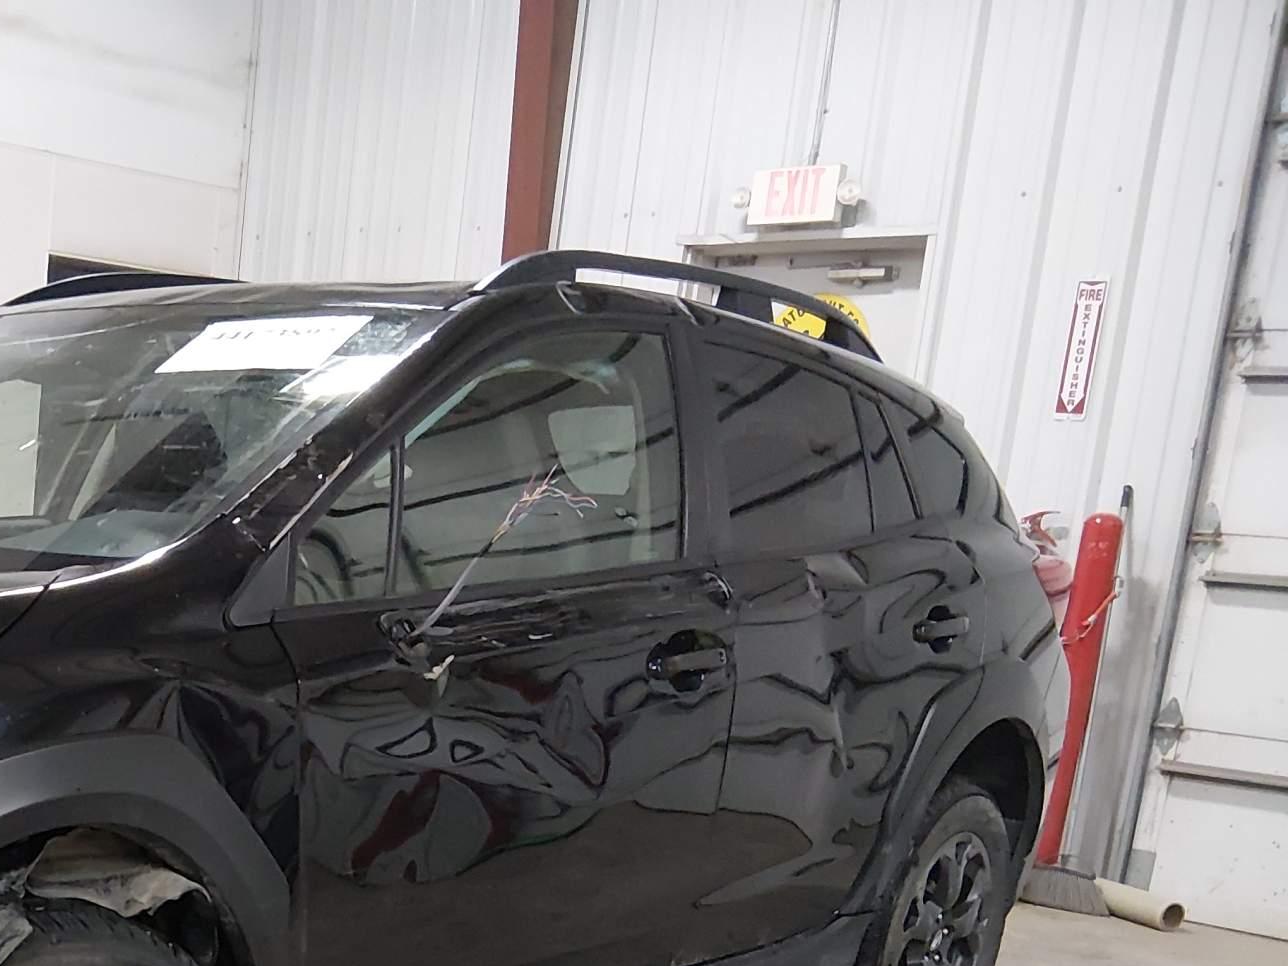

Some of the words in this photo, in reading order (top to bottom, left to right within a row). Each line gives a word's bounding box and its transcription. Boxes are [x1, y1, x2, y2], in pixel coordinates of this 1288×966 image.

[764, 167, 826, 217] EXIT
[1078, 288, 1103, 302] FIRE
[1067, 303, 1092, 407] EXTINGUISHER
